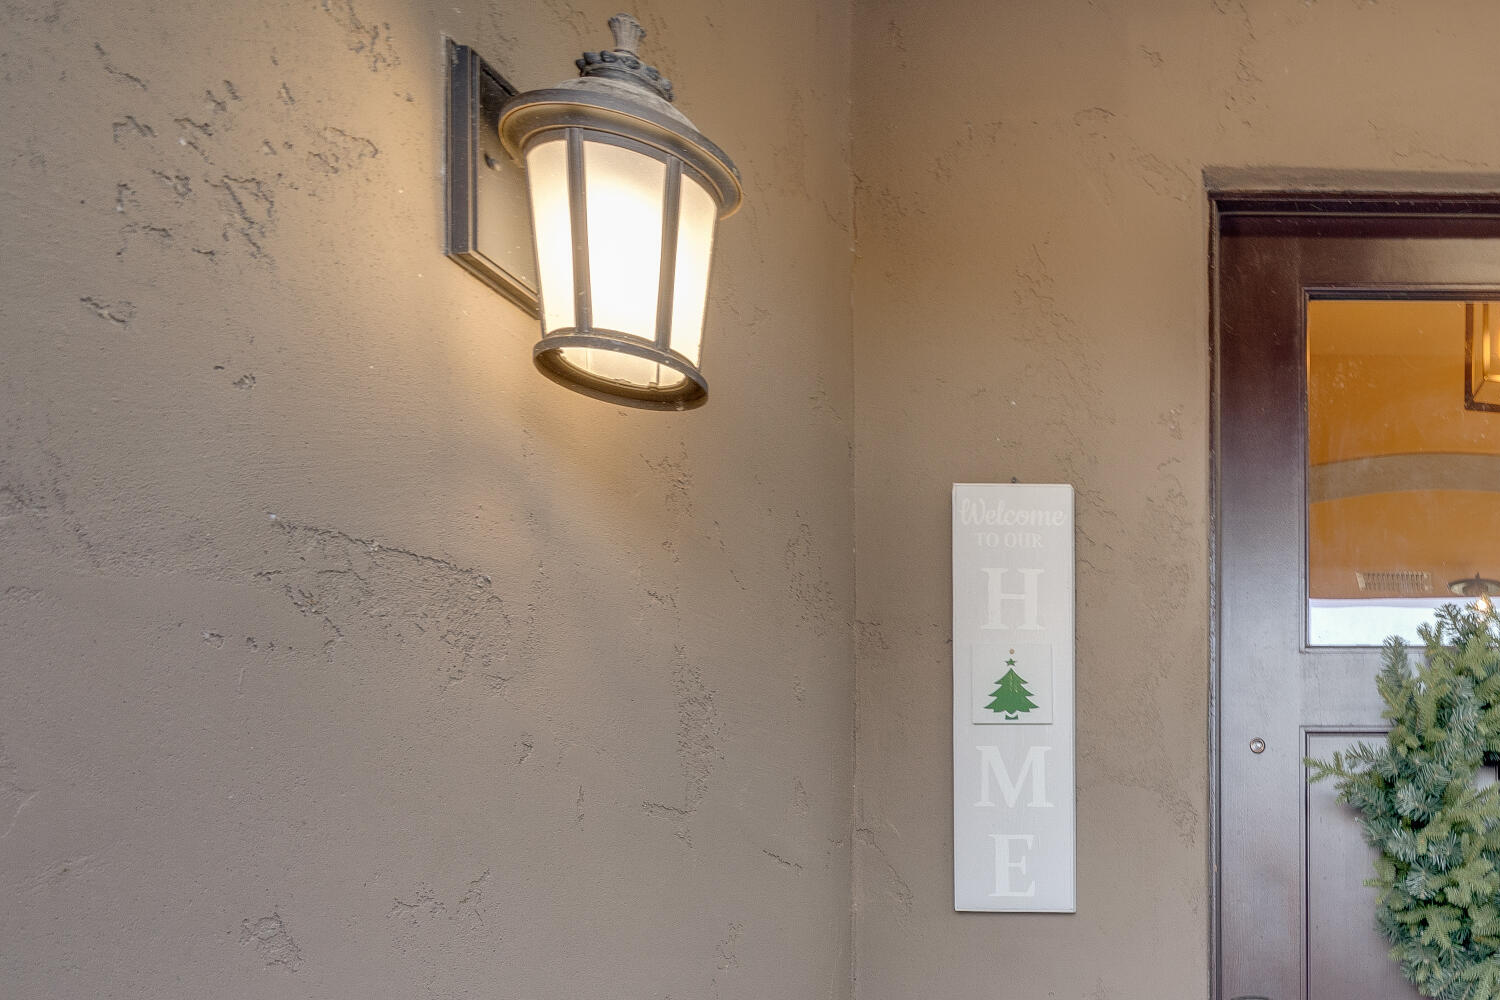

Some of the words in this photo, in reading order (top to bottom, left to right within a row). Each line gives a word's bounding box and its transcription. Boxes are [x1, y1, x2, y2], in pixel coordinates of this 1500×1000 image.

[959, 497, 1066, 527] Welcome
[976, 532, 999, 548] TO
[1003, 532, 1044, 548] OUR
